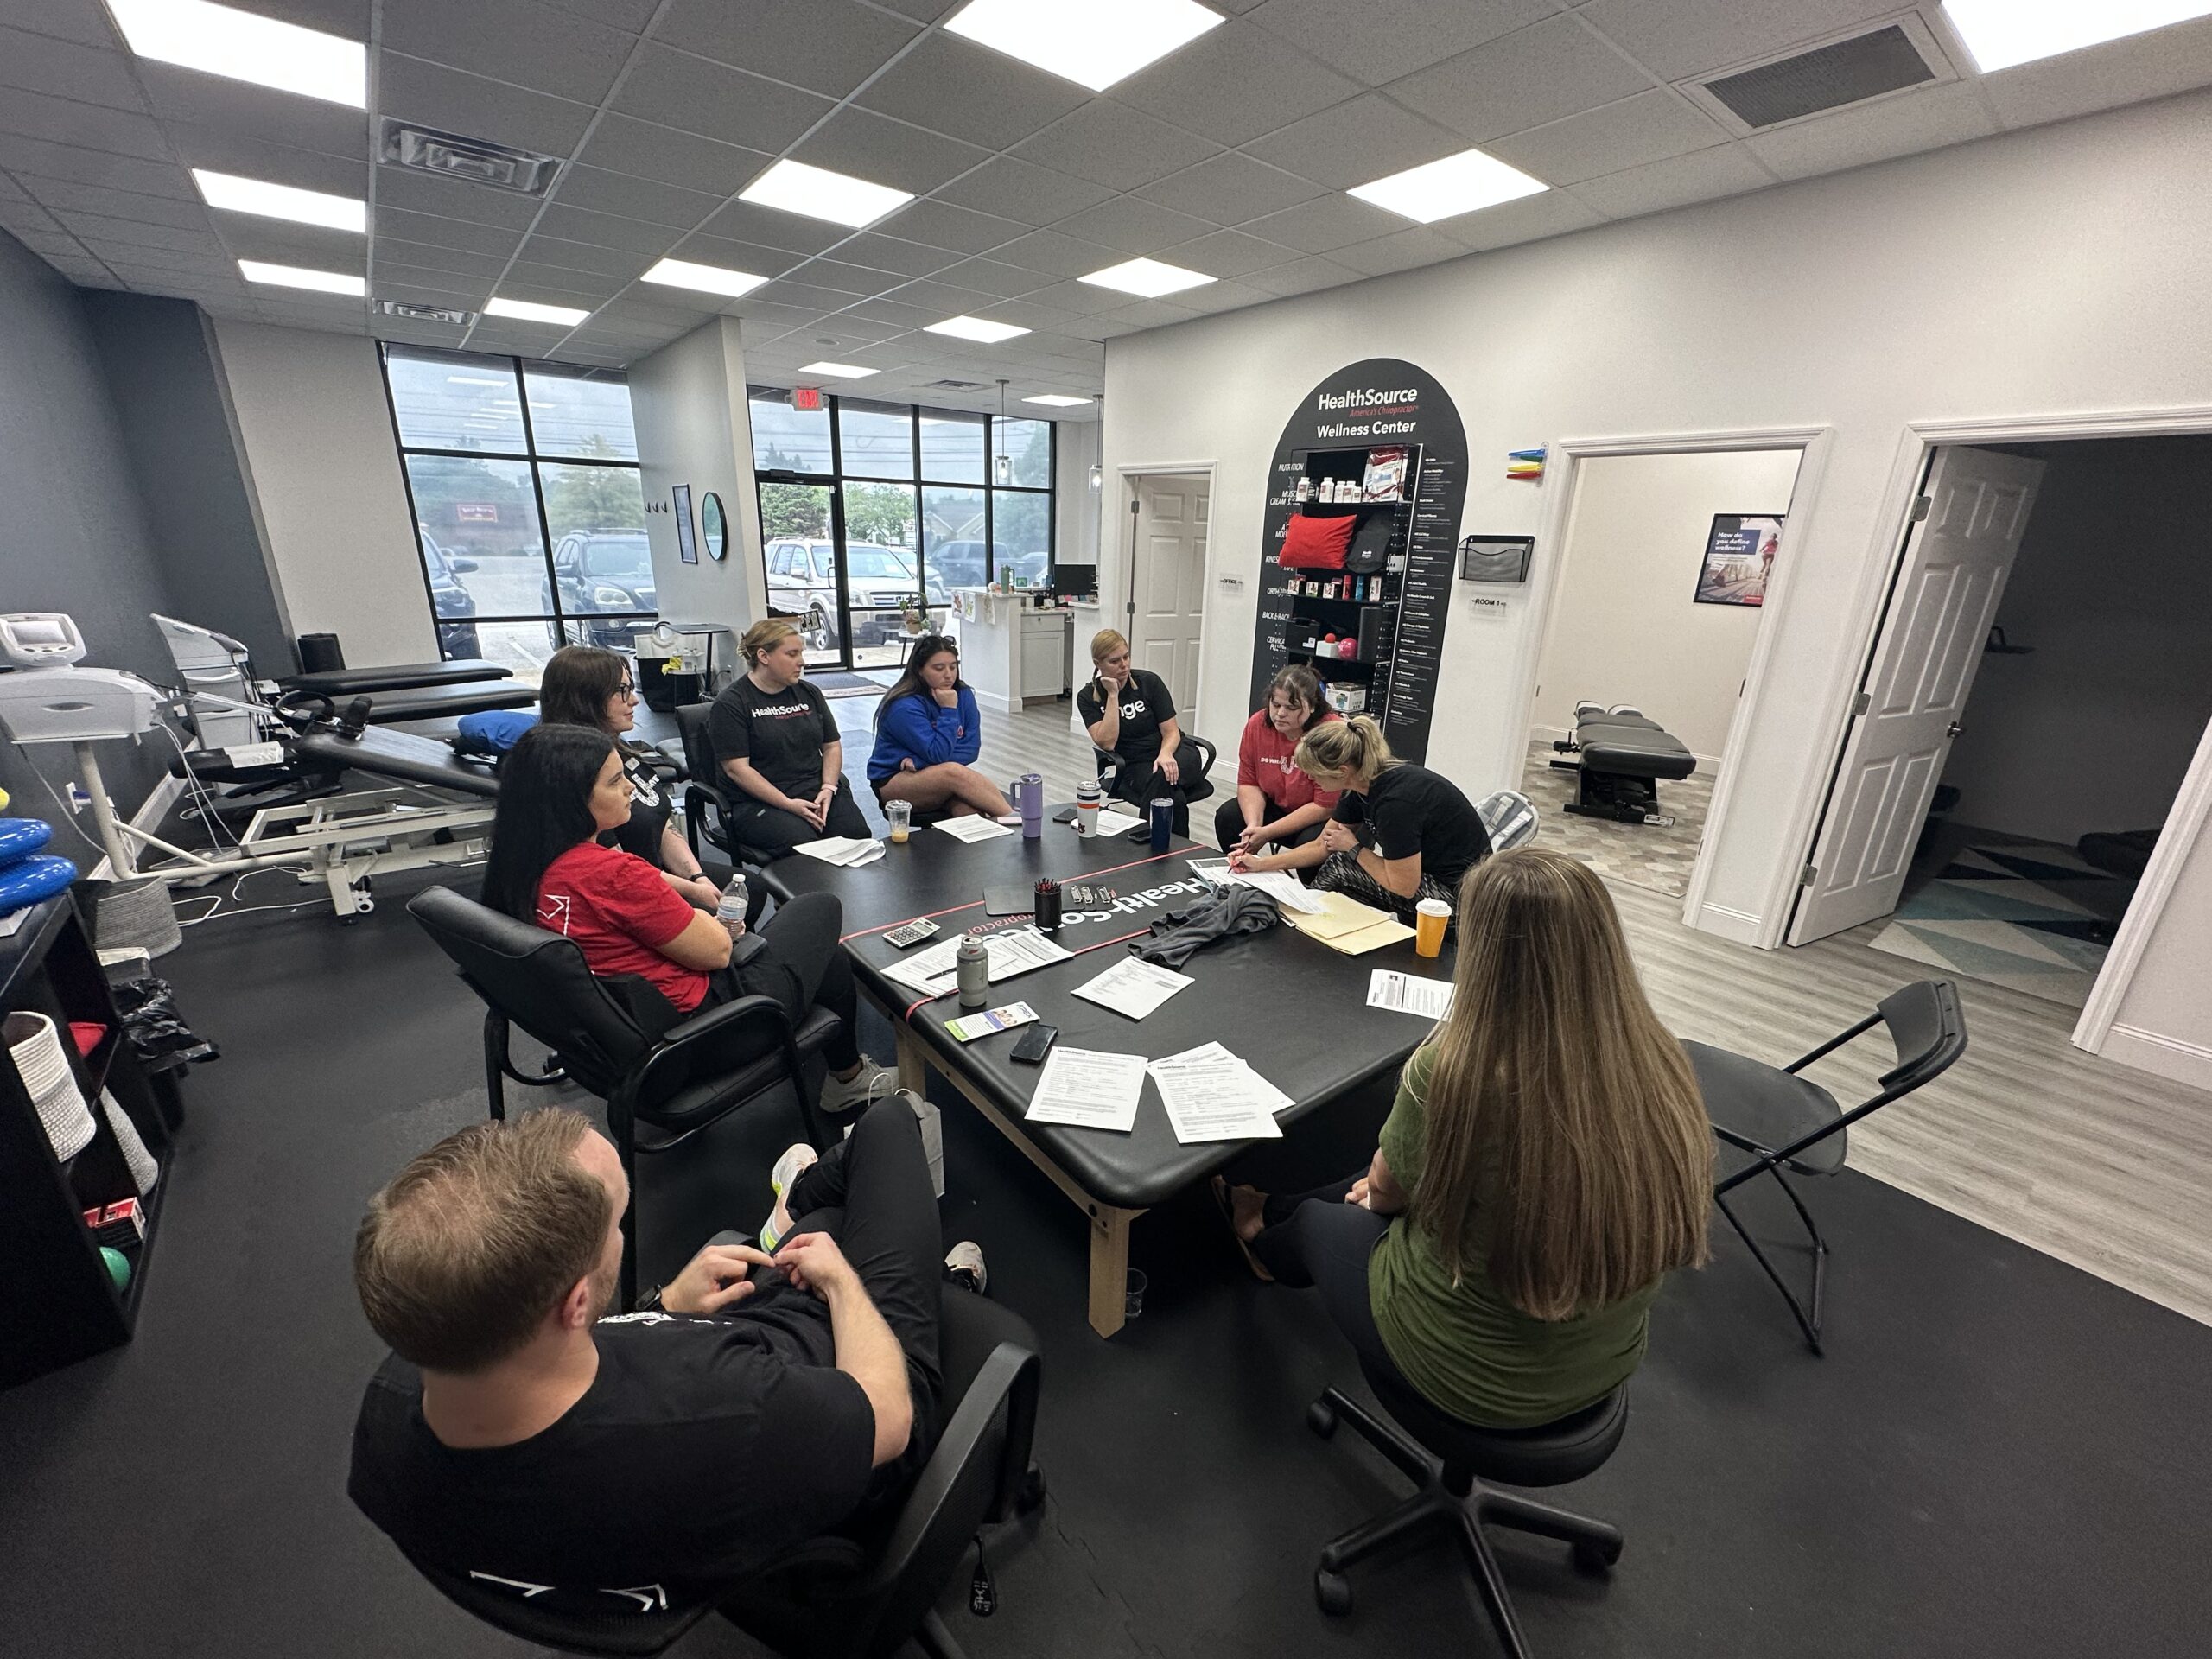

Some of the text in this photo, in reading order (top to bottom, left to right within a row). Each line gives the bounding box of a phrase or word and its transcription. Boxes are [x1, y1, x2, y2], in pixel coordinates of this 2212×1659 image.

[1318, 388, 1418, 410] HealthSource
[1349, 409, 1377, 418] America's
[1317, 420, 1417, 439] Wellness Center
